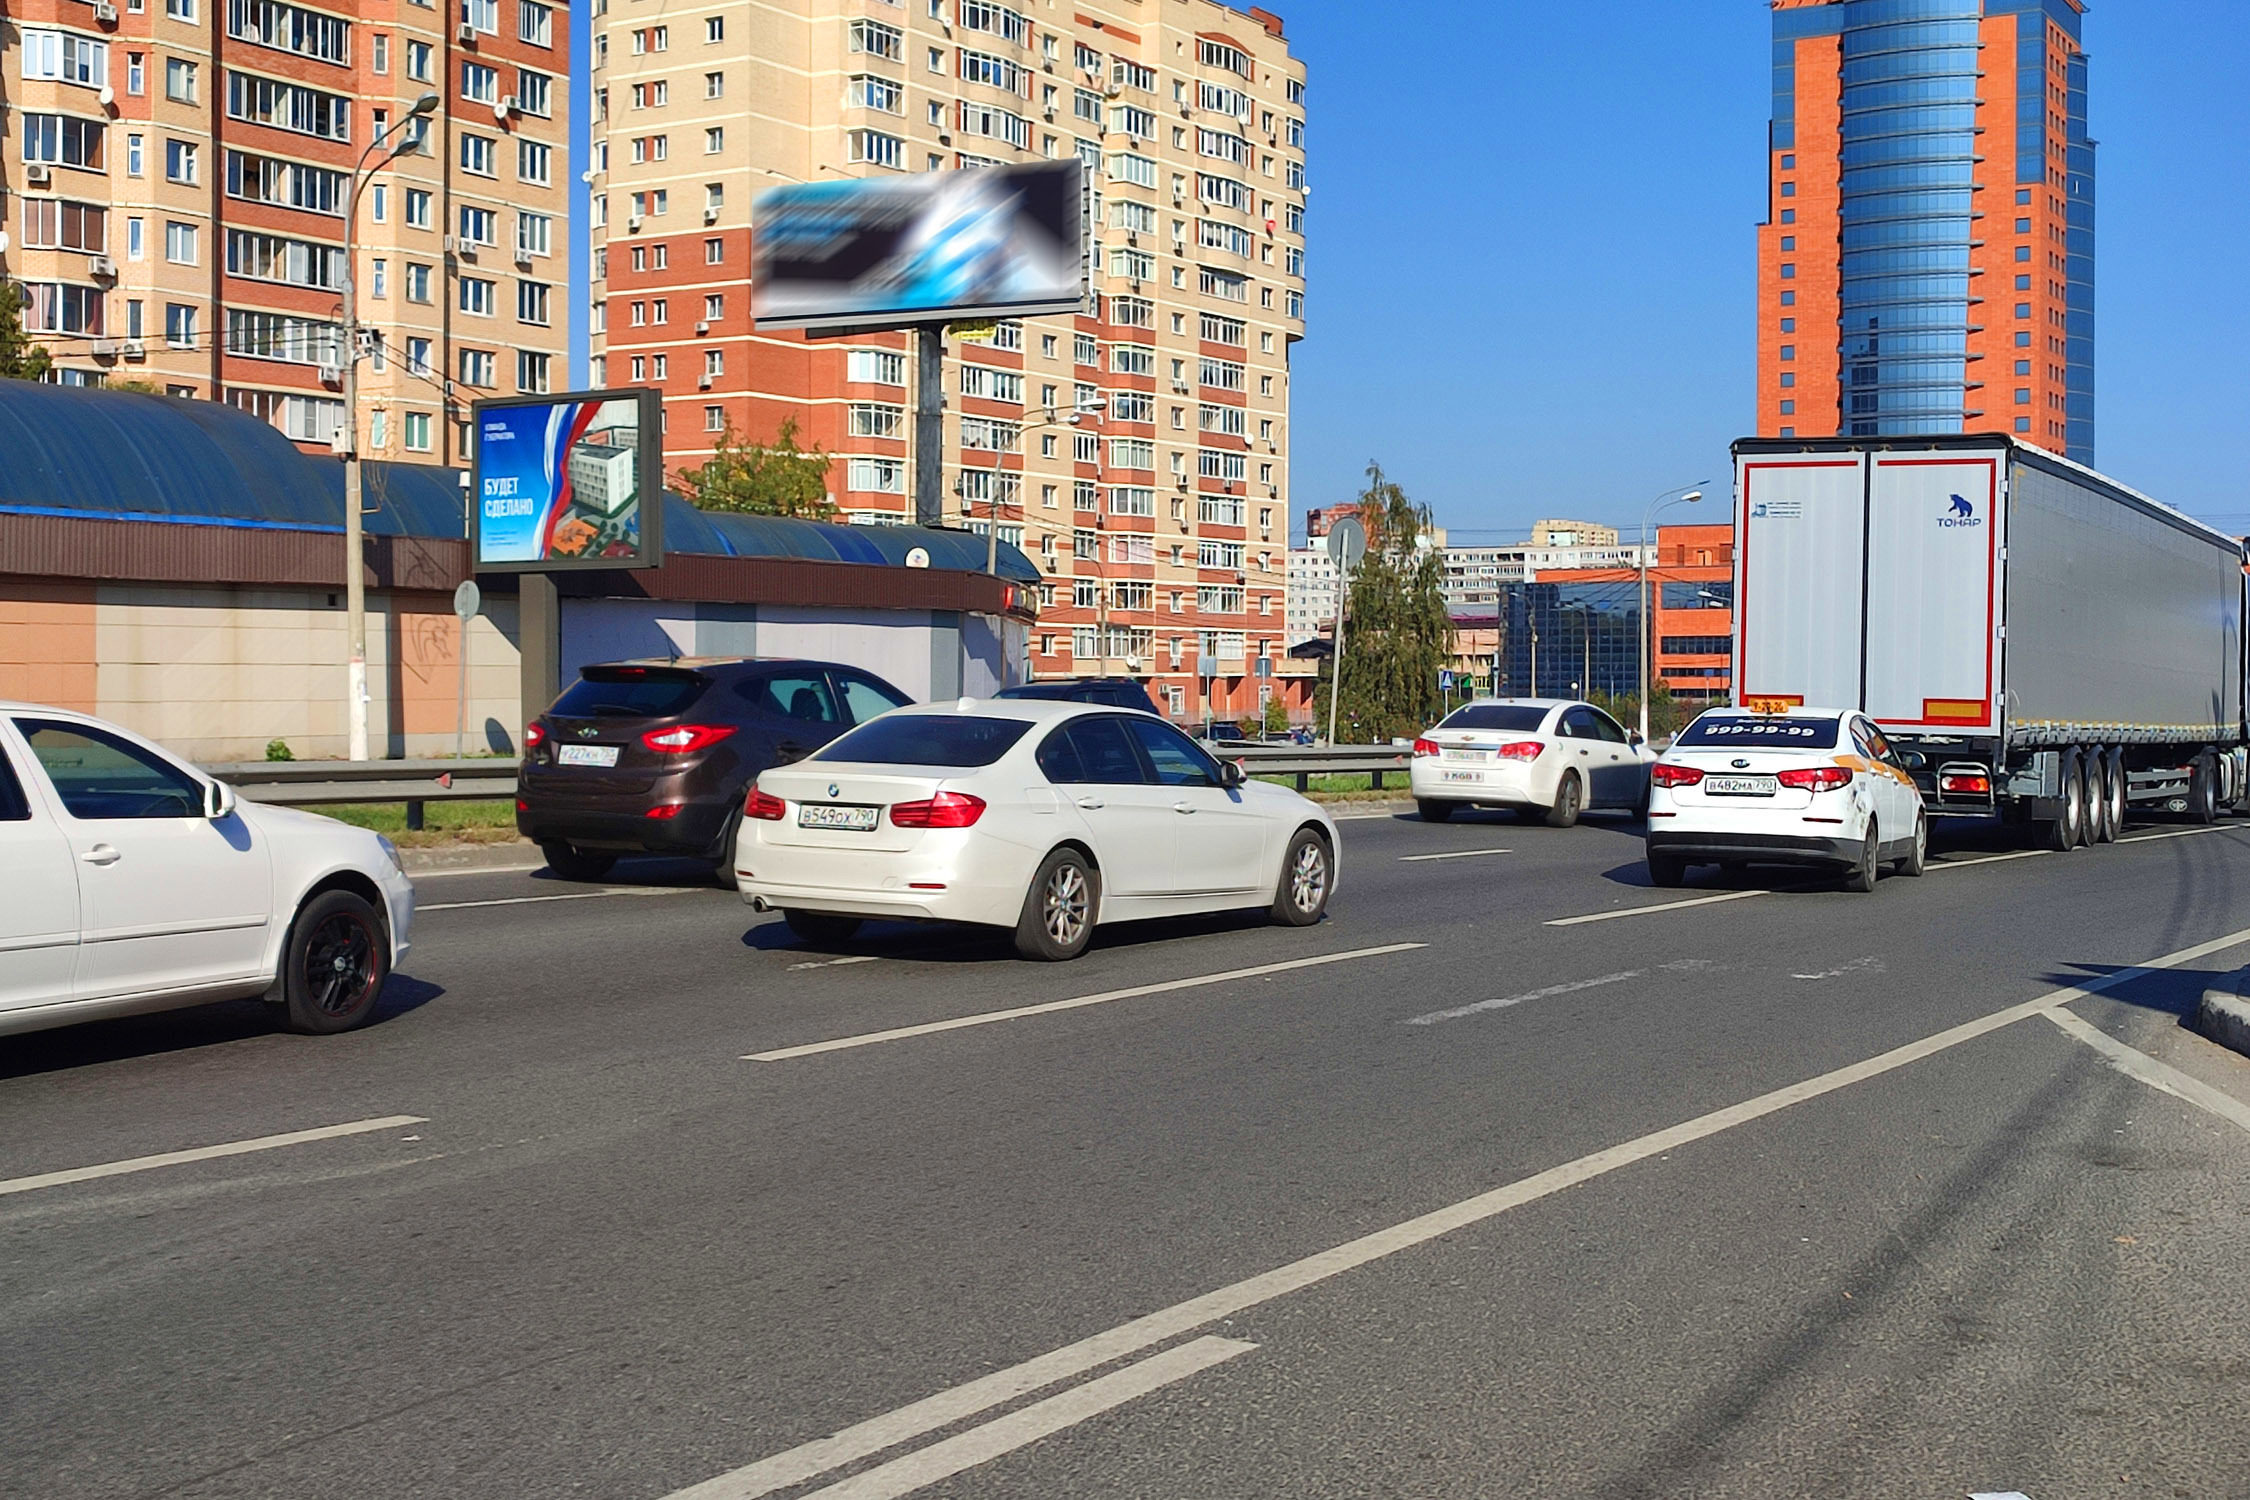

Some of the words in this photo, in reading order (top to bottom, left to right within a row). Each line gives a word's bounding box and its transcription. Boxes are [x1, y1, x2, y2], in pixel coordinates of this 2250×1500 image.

[484, 477, 519, 496] БУДЕТ
[485, 498, 534, 518] СДЕЛАНО
[1936, 518, 1982, 528] ТОНАР
[1704, 725, 1815, 736] 999-99-99
[1709, 779, 1753, 791] В482МА
[1756, 780, 1773, 789] 790
[803, 807, 852, 824] В549ОХ
[855, 808, 874, 822] 790
